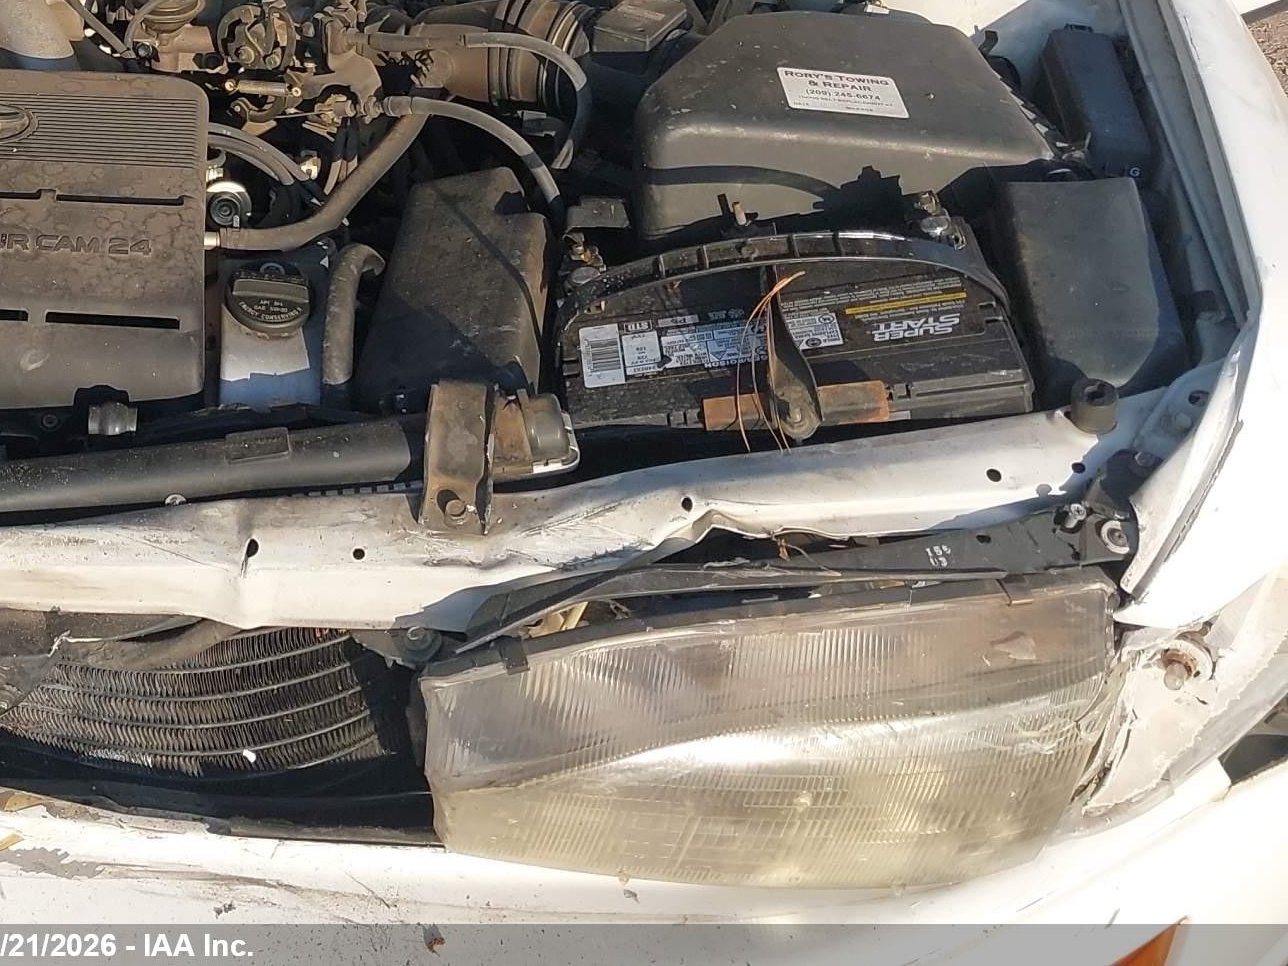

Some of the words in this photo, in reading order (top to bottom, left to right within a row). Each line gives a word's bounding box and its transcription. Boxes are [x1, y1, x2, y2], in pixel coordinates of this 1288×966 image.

[784, 70, 833, 81] RORY'S
[836, 75, 890, 86] TOWING
[808, 79, 819, 87] &
[823, 81, 873, 92] REPAIR
[35, 234, 101, 254] CAM
[107, 237, 153, 257] 24
[871, 312, 961, 334] START
[873, 324, 953, 342] SUPER
